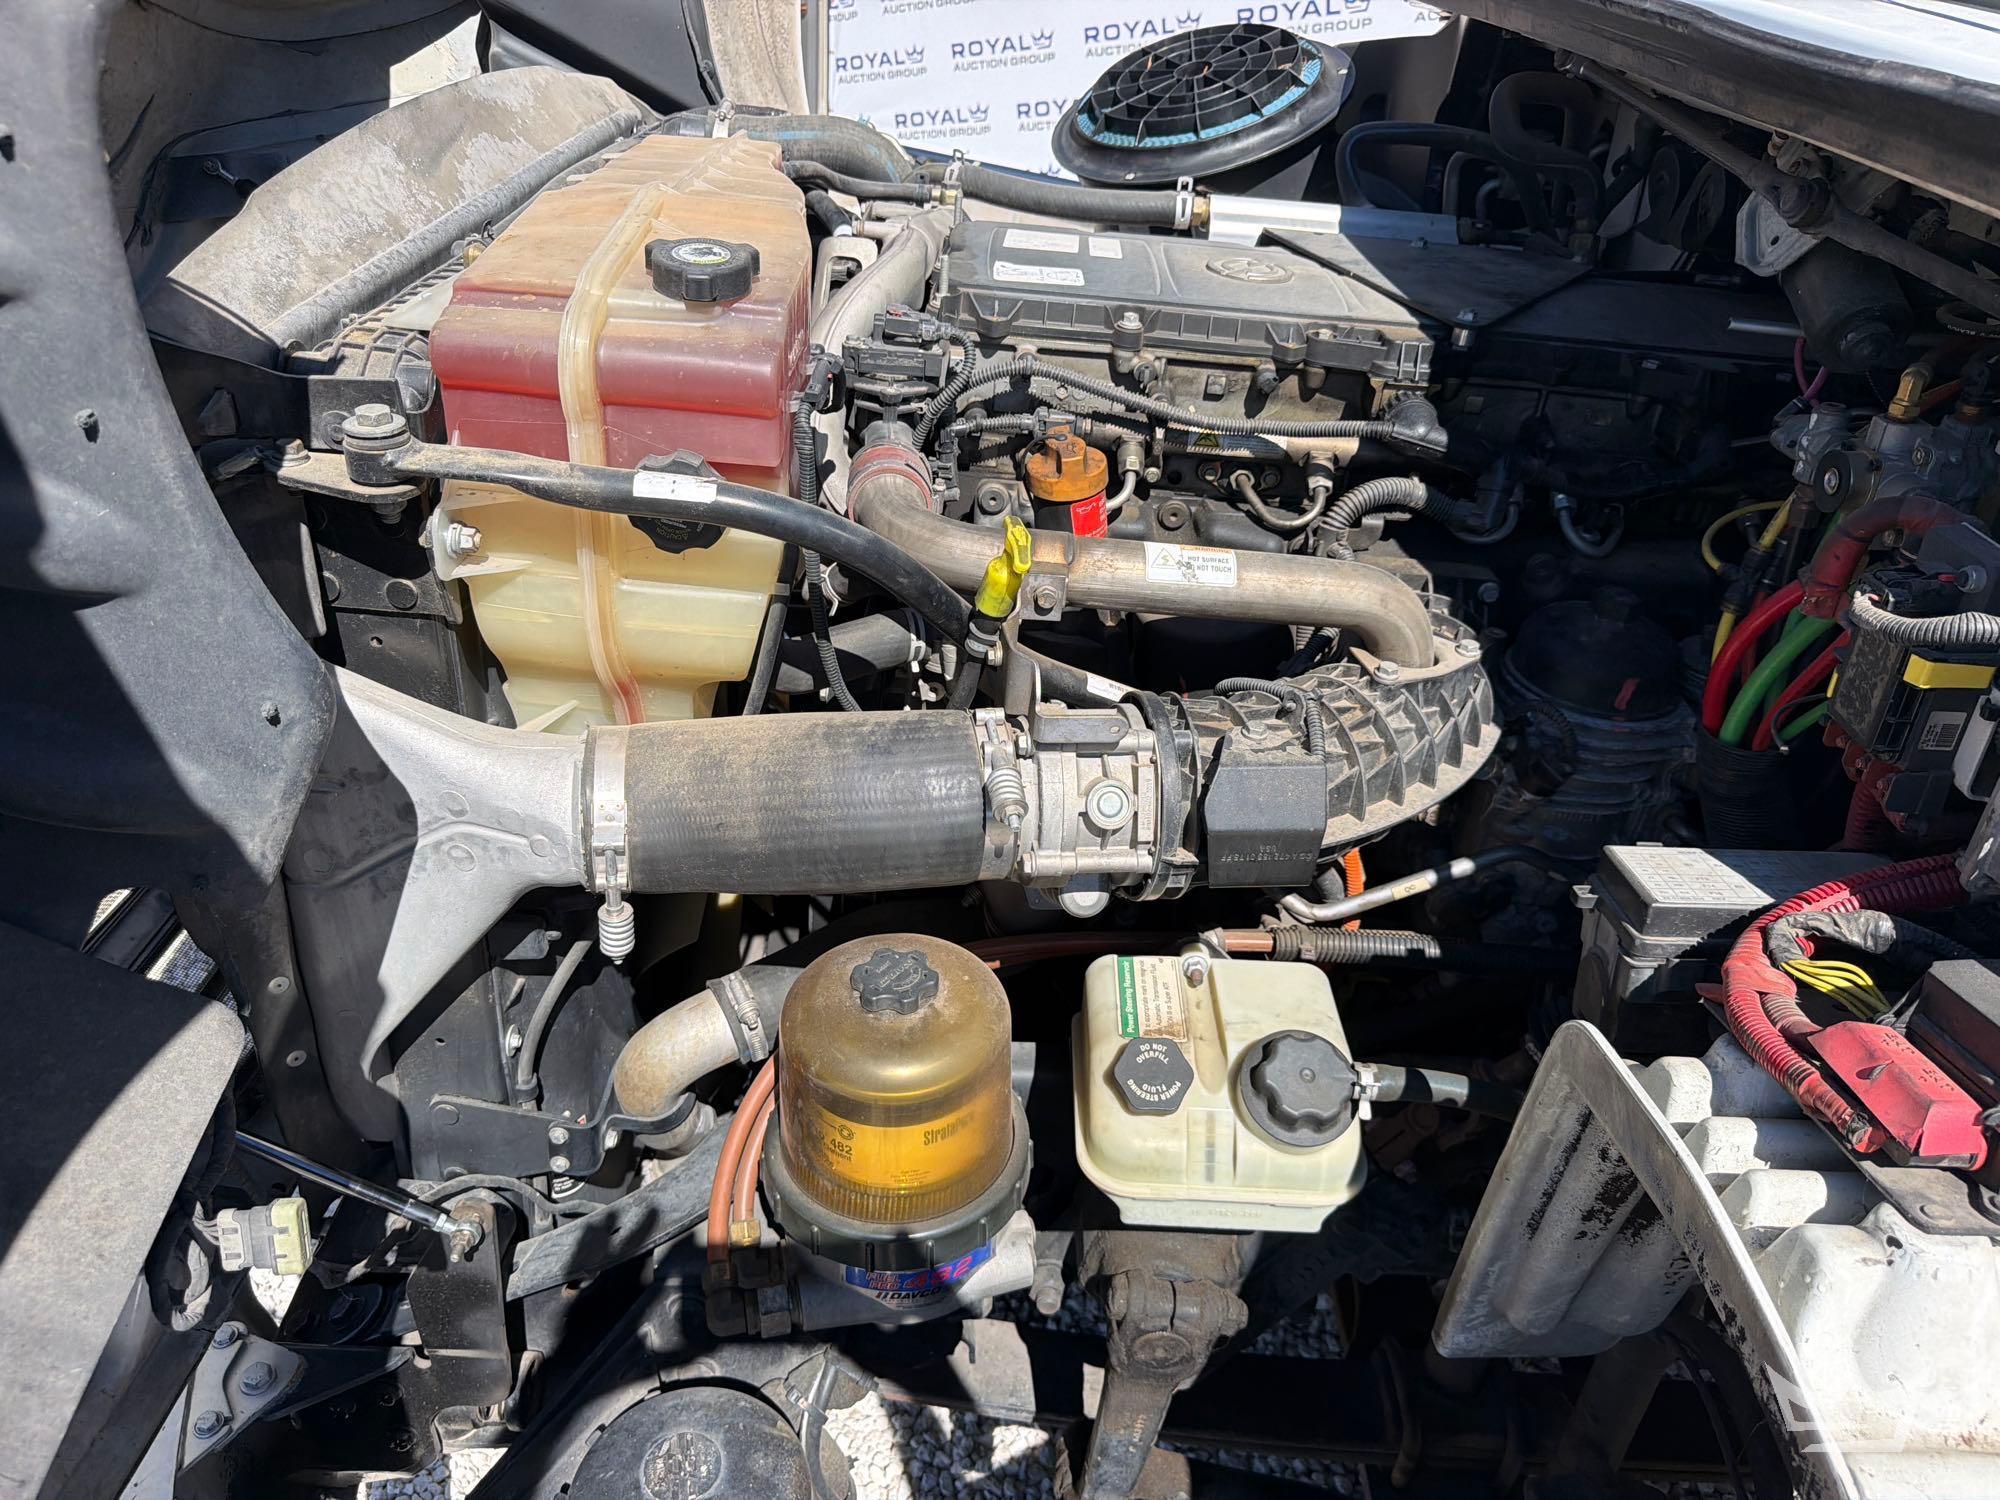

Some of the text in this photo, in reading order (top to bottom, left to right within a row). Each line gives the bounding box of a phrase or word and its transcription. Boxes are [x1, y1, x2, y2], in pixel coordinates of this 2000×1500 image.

[1236, 0, 1341, 25] ROYAL
[1084, 18, 1175, 44] ROYAL
[1311, 18, 1373, 34] GROUP
[951, 35, 1031, 59] ROYAL
[836, 49, 905, 73] ROYAL
[953, 52, 1057, 73] AUCTION GROUP
[838, 67, 928, 85] AUCTION GROUP
[895, 108, 969, 128] ROYAL
[1017, 98, 1068, 119] ROY
[897, 125, 991, 141] AUCTION GROUP
[1202, 556, 1229, 564] SURFACE
[1122, 961, 1135, 1033] Power Steering Reservoir
[1136, 1050, 1169, 1064] OVERFILL
[1139, 1043, 1167, 1052] DO NOT
[1127, 1078, 1181, 1101] POWER STEERING
[1142, 1083, 1167, 1093] FLUID
[830, 1138, 853, 1156] 482
[890, 1286, 944, 1300] DAVCO
